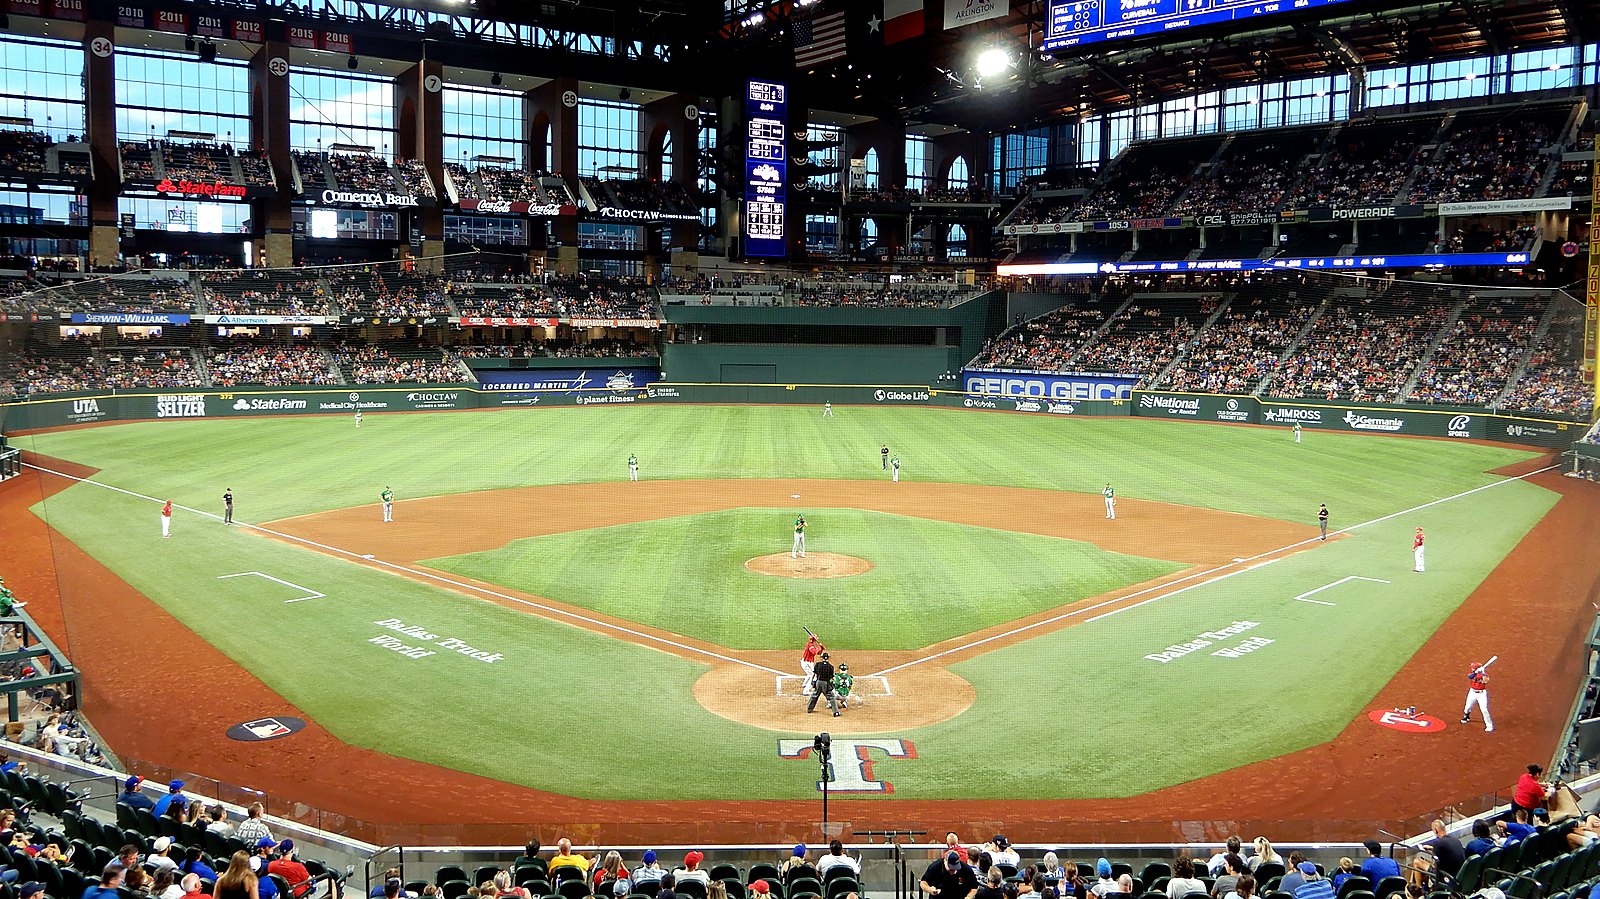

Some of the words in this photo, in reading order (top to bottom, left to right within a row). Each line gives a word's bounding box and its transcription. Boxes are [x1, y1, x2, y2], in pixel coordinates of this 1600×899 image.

[118, 6, 144, 18] 2010
[160, 11, 183, 23] 2011
[956, 4, 994, 19] ARLINGTON
[1055, 7, 1068, 15] BALL
[1122, 8, 1157, 20] CURVEBALL
[198, 16, 222, 28] 2011
[236, 21, 260, 33] 2012
[290, 28, 314, 39] 2015
[326, 32, 349, 43] 2016
[94, 41, 111, 54] 34
[271, 61, 286, 73] 26
[430, 79, 437, 88] 7
[564, 94, 576, 104] 29
[686, 107, 696, 117] 10
[386, 194, 418, 206] Bank
[477, 200, 512, 213] Coca-Cola
[528, 203, 562, 216] Coca-Cola
[607, 207, 660, 219] CHOCTAW
[1332, 207, 1396, 219] POWERADE
[1108, 221, 1128, 229] 105.3
[1204, 216, 1226, 224] PGL
[966, 377, 1046, 401] GEICO
[413, 393, 458, 401] CHOCTAW
[584, 395, 608, 404] planet
[887, 392, 912, 400] Globe
[74, 399, 99, 413] UTA
[157, 401, 206, 417] SELTZER
[344, 402, 356, 410] City
[974, 400, 996, 408] Kubota
[1360, 416, 1403, 427] Germania
[368, 634, 437, 659] World
[373, 618, 440, 641] Dallas
[435, 637, 504, 664] Truck
[1143, 638, 1213, 663] Dallas
[1197, 620, 1262, 641] Truck
[1209, 636, 1277, 658] World
[777, 738, 919, 794] T
